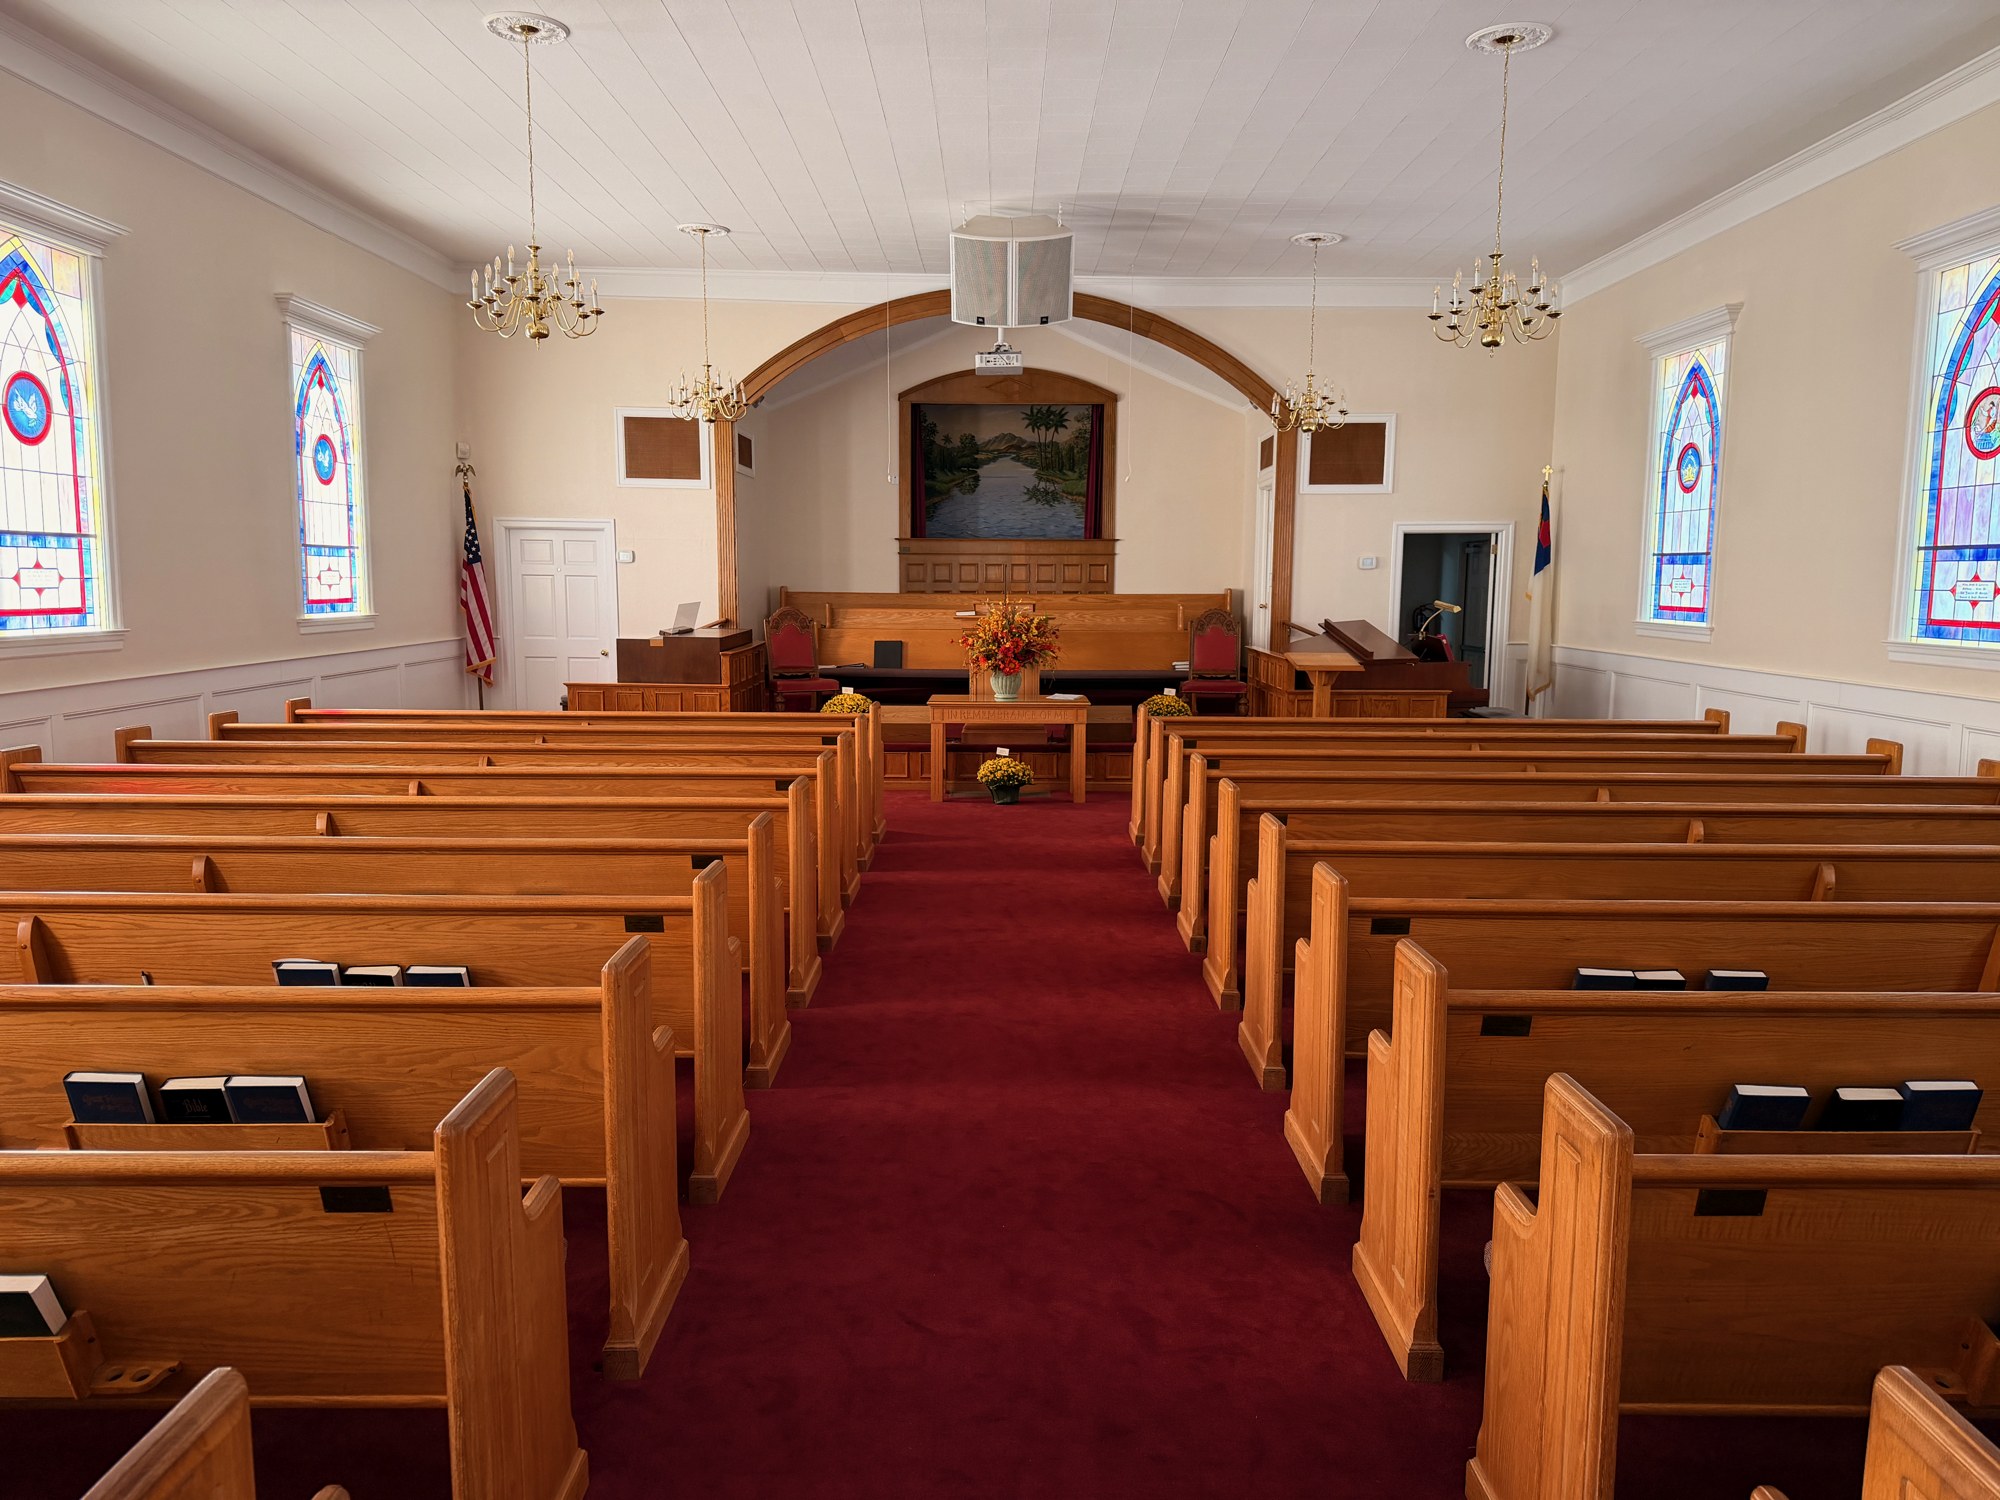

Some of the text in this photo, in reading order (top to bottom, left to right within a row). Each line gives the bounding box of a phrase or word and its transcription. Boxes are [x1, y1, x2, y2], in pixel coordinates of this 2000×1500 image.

[947, 709, 1069, 720] IN REMEMBRANCE OF ME
[182, 1097, 209, 1115] Bible
